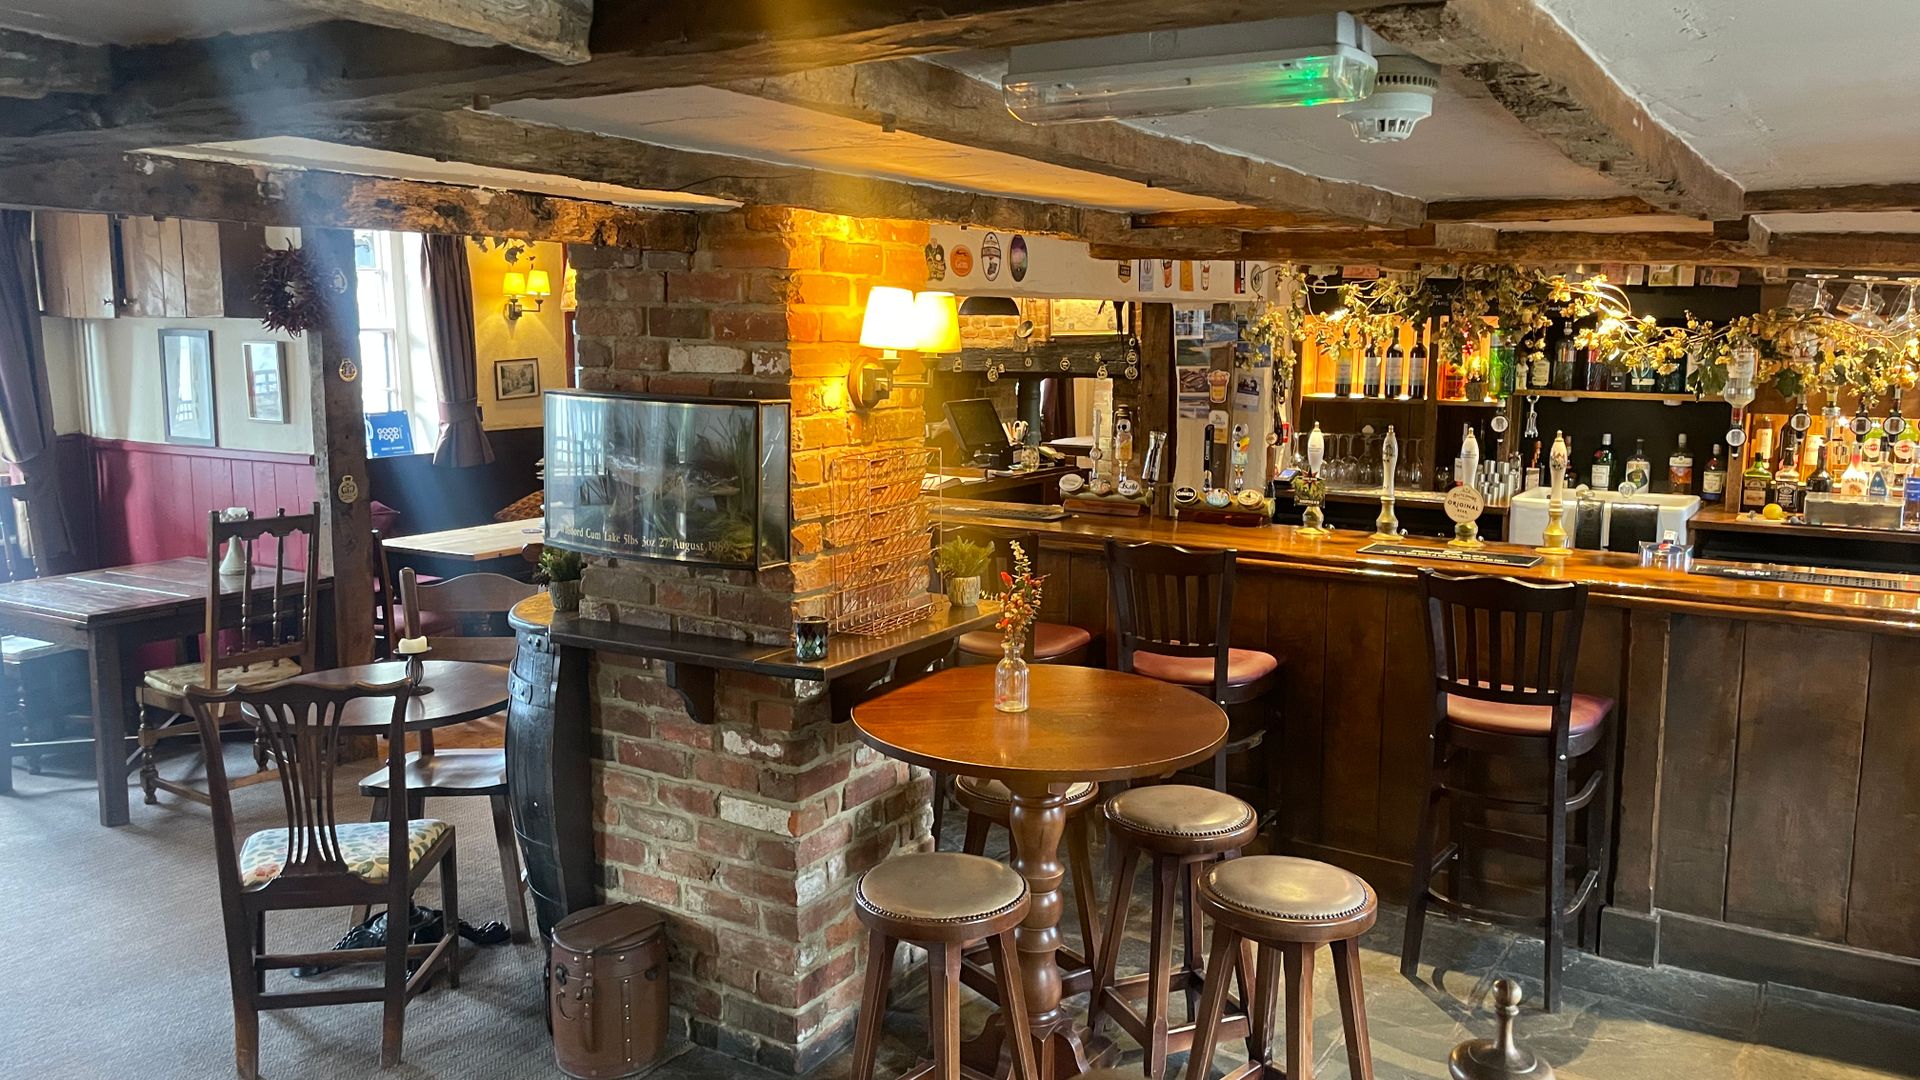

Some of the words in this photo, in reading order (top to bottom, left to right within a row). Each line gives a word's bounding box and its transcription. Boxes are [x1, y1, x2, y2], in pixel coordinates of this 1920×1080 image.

[379, 433, 400, 441] FOOD
[1447, 500, 1479, 511] ORIGINAL
[586, 528, 601, 540] Cum
[604, 531, 620, 543] Lake
[623, 534, 639, 545] 5lbs
[641, 536, 655, 547] 3oz
